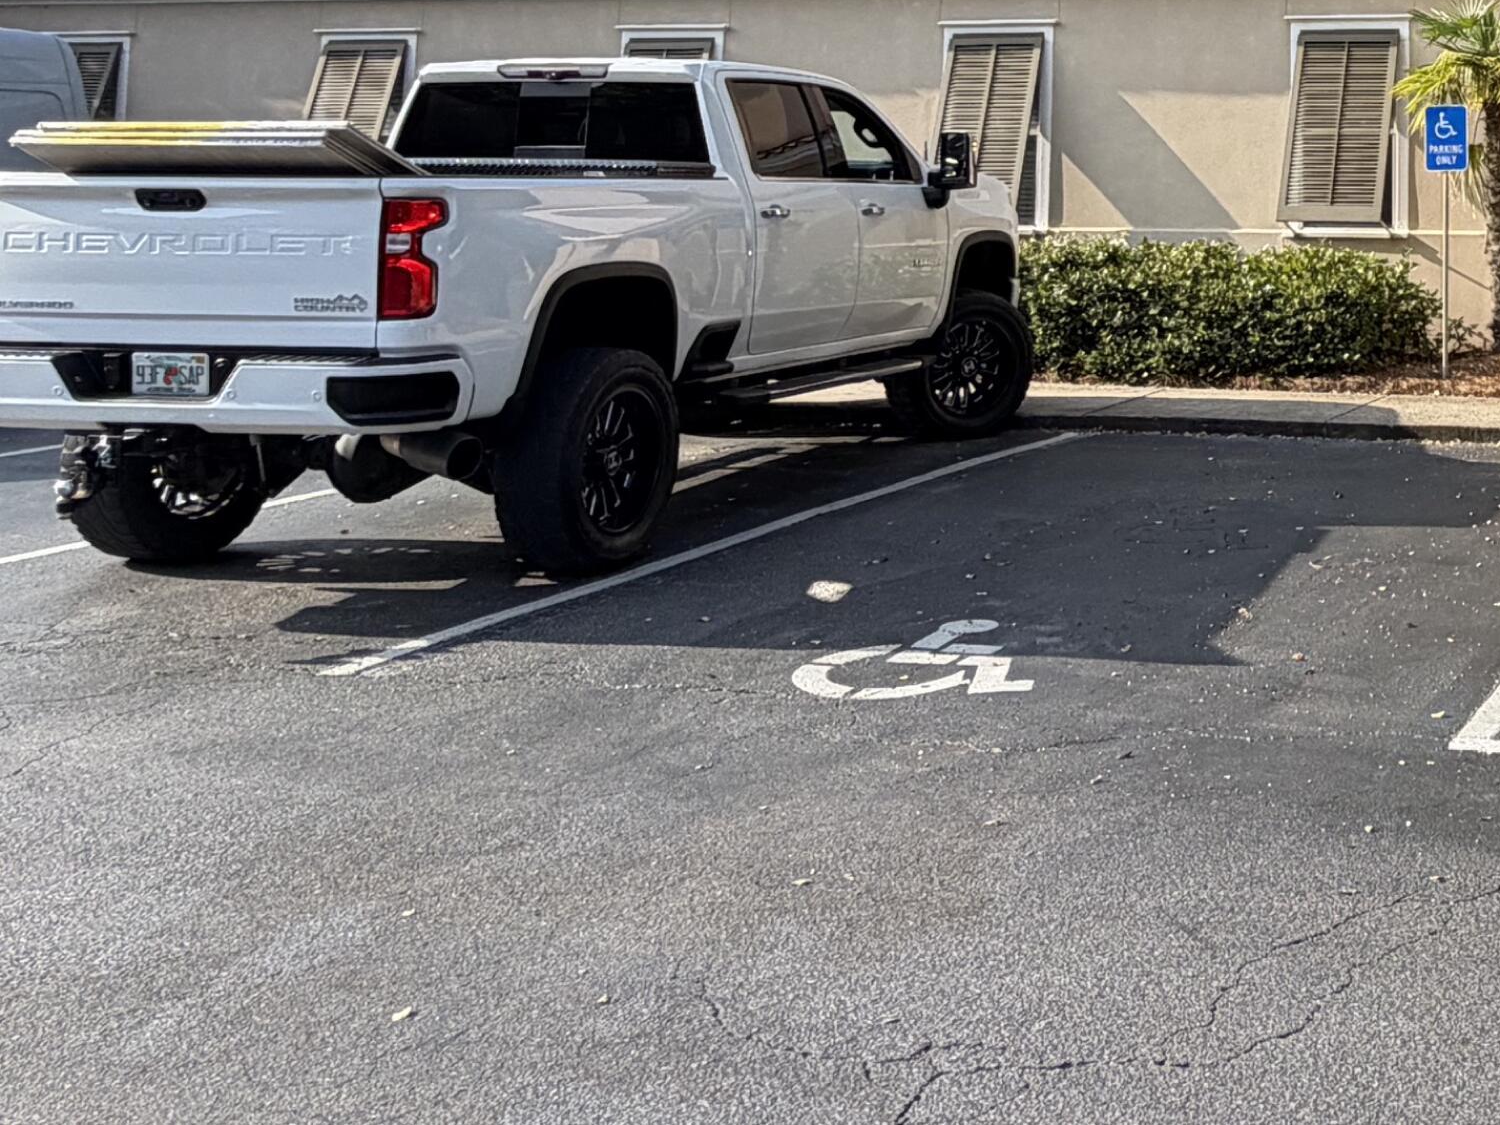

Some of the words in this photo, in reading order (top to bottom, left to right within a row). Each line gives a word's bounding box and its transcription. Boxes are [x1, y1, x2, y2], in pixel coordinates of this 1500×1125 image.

[1428, 144, 1464, 154] PARKING
[1435, 155, 1457, 165] ONLY
[4, 230, 352, 256] CHEVROLET
